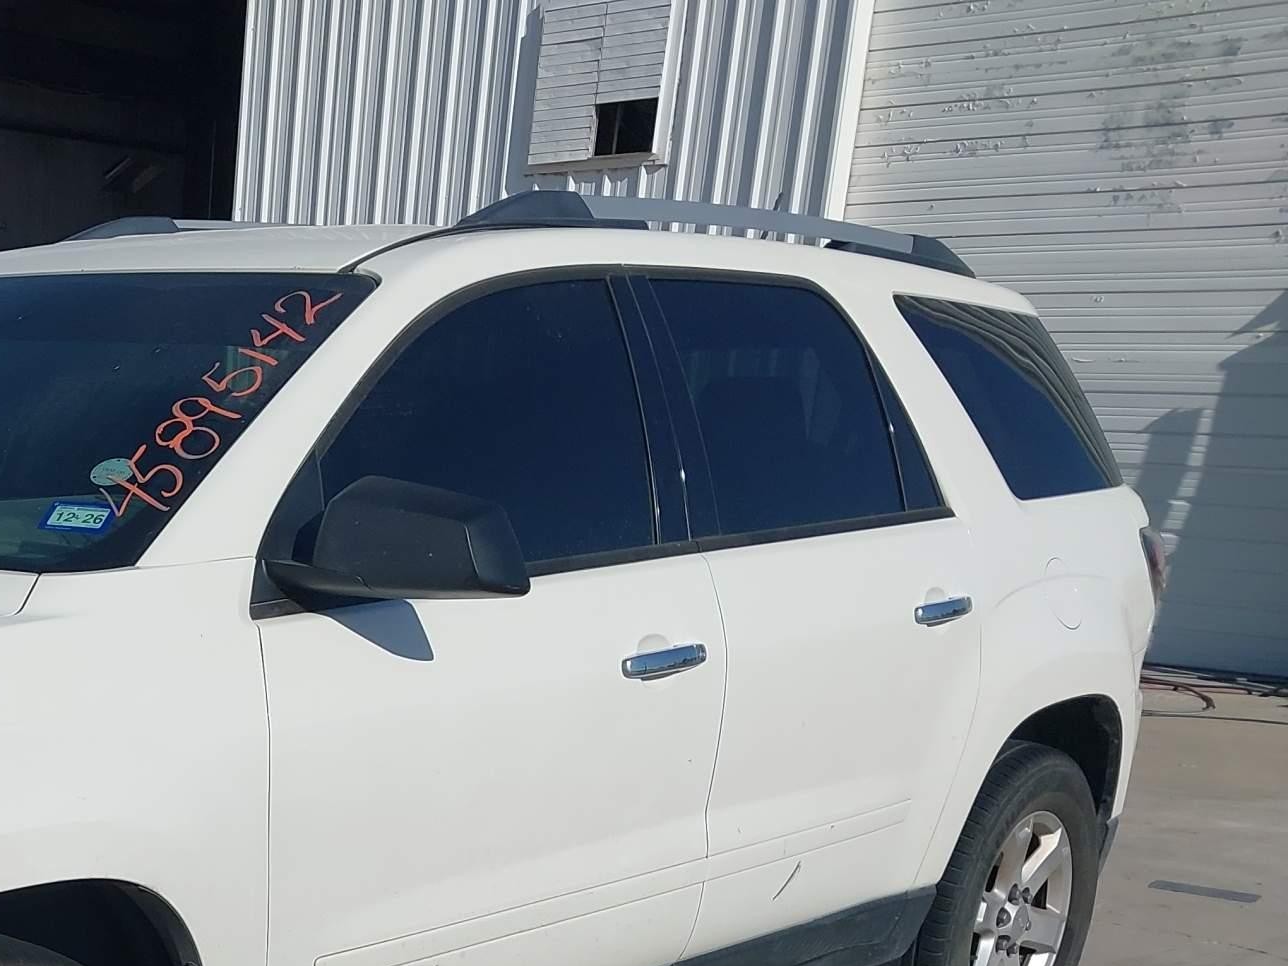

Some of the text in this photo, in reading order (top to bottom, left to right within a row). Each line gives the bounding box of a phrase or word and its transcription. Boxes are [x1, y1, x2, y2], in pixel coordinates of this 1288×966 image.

[98, 289, 344, 518] 45895142
[55, 511, 105, 525] 12 26
